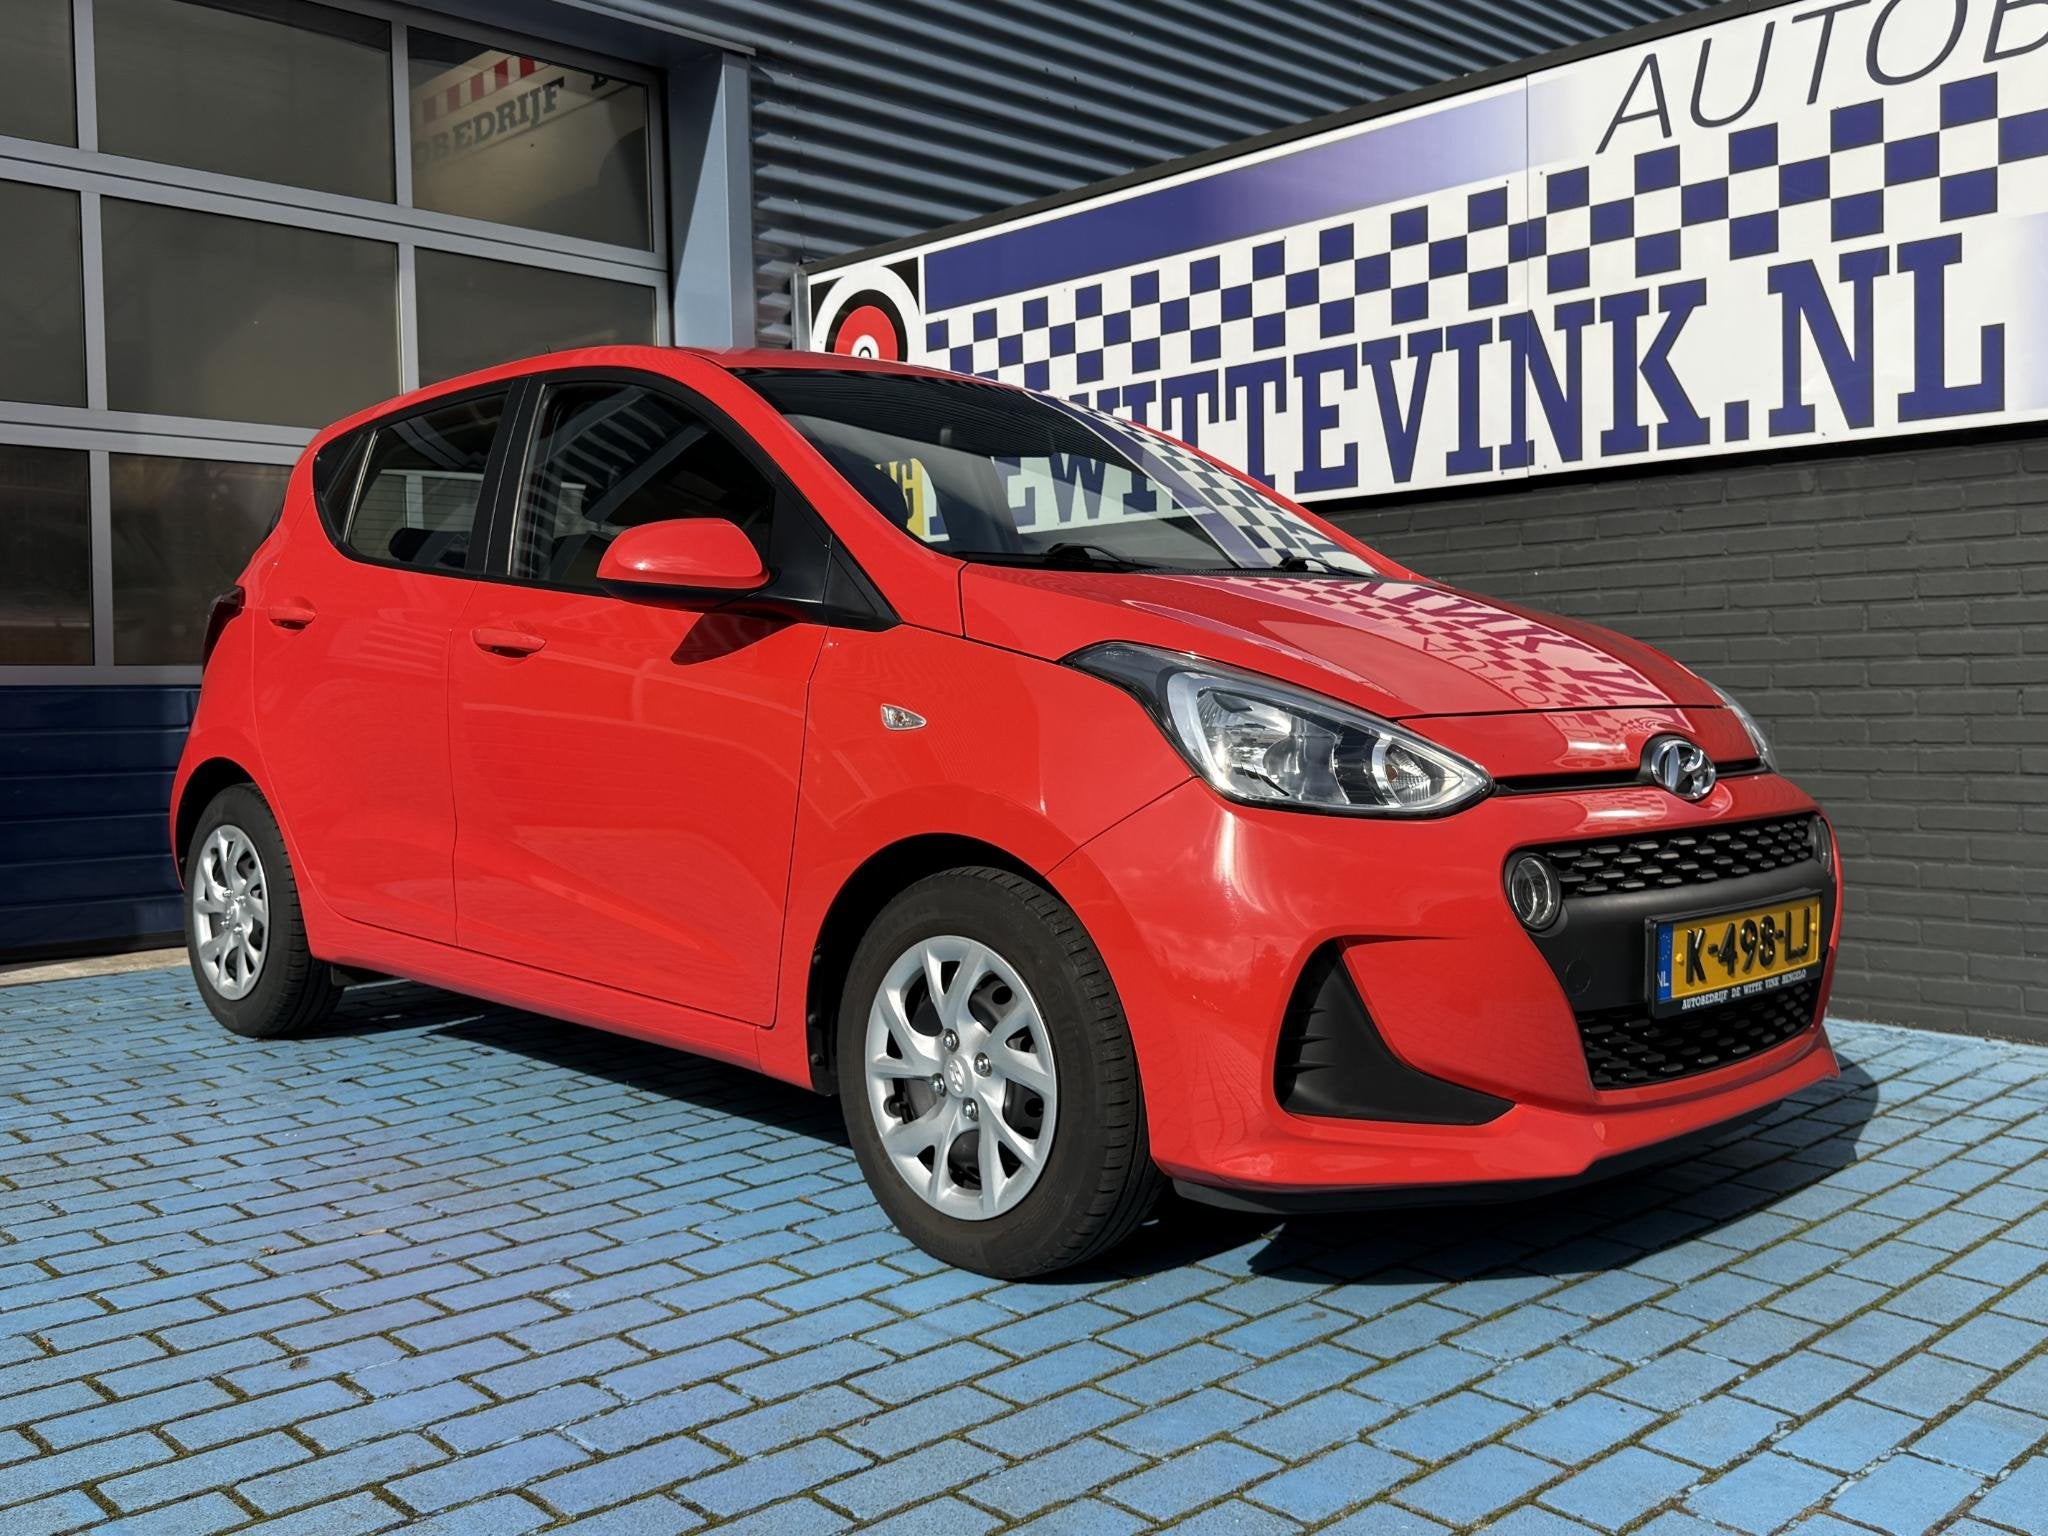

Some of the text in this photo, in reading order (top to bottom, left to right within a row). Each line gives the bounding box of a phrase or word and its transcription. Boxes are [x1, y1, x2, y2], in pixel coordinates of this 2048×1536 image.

[1686, 906, 1810, 985] K-498-LJ
[1681, 989, 1729, 1011] AUTOBEDRIJF
[1731, 987, 1741, 998] DE
